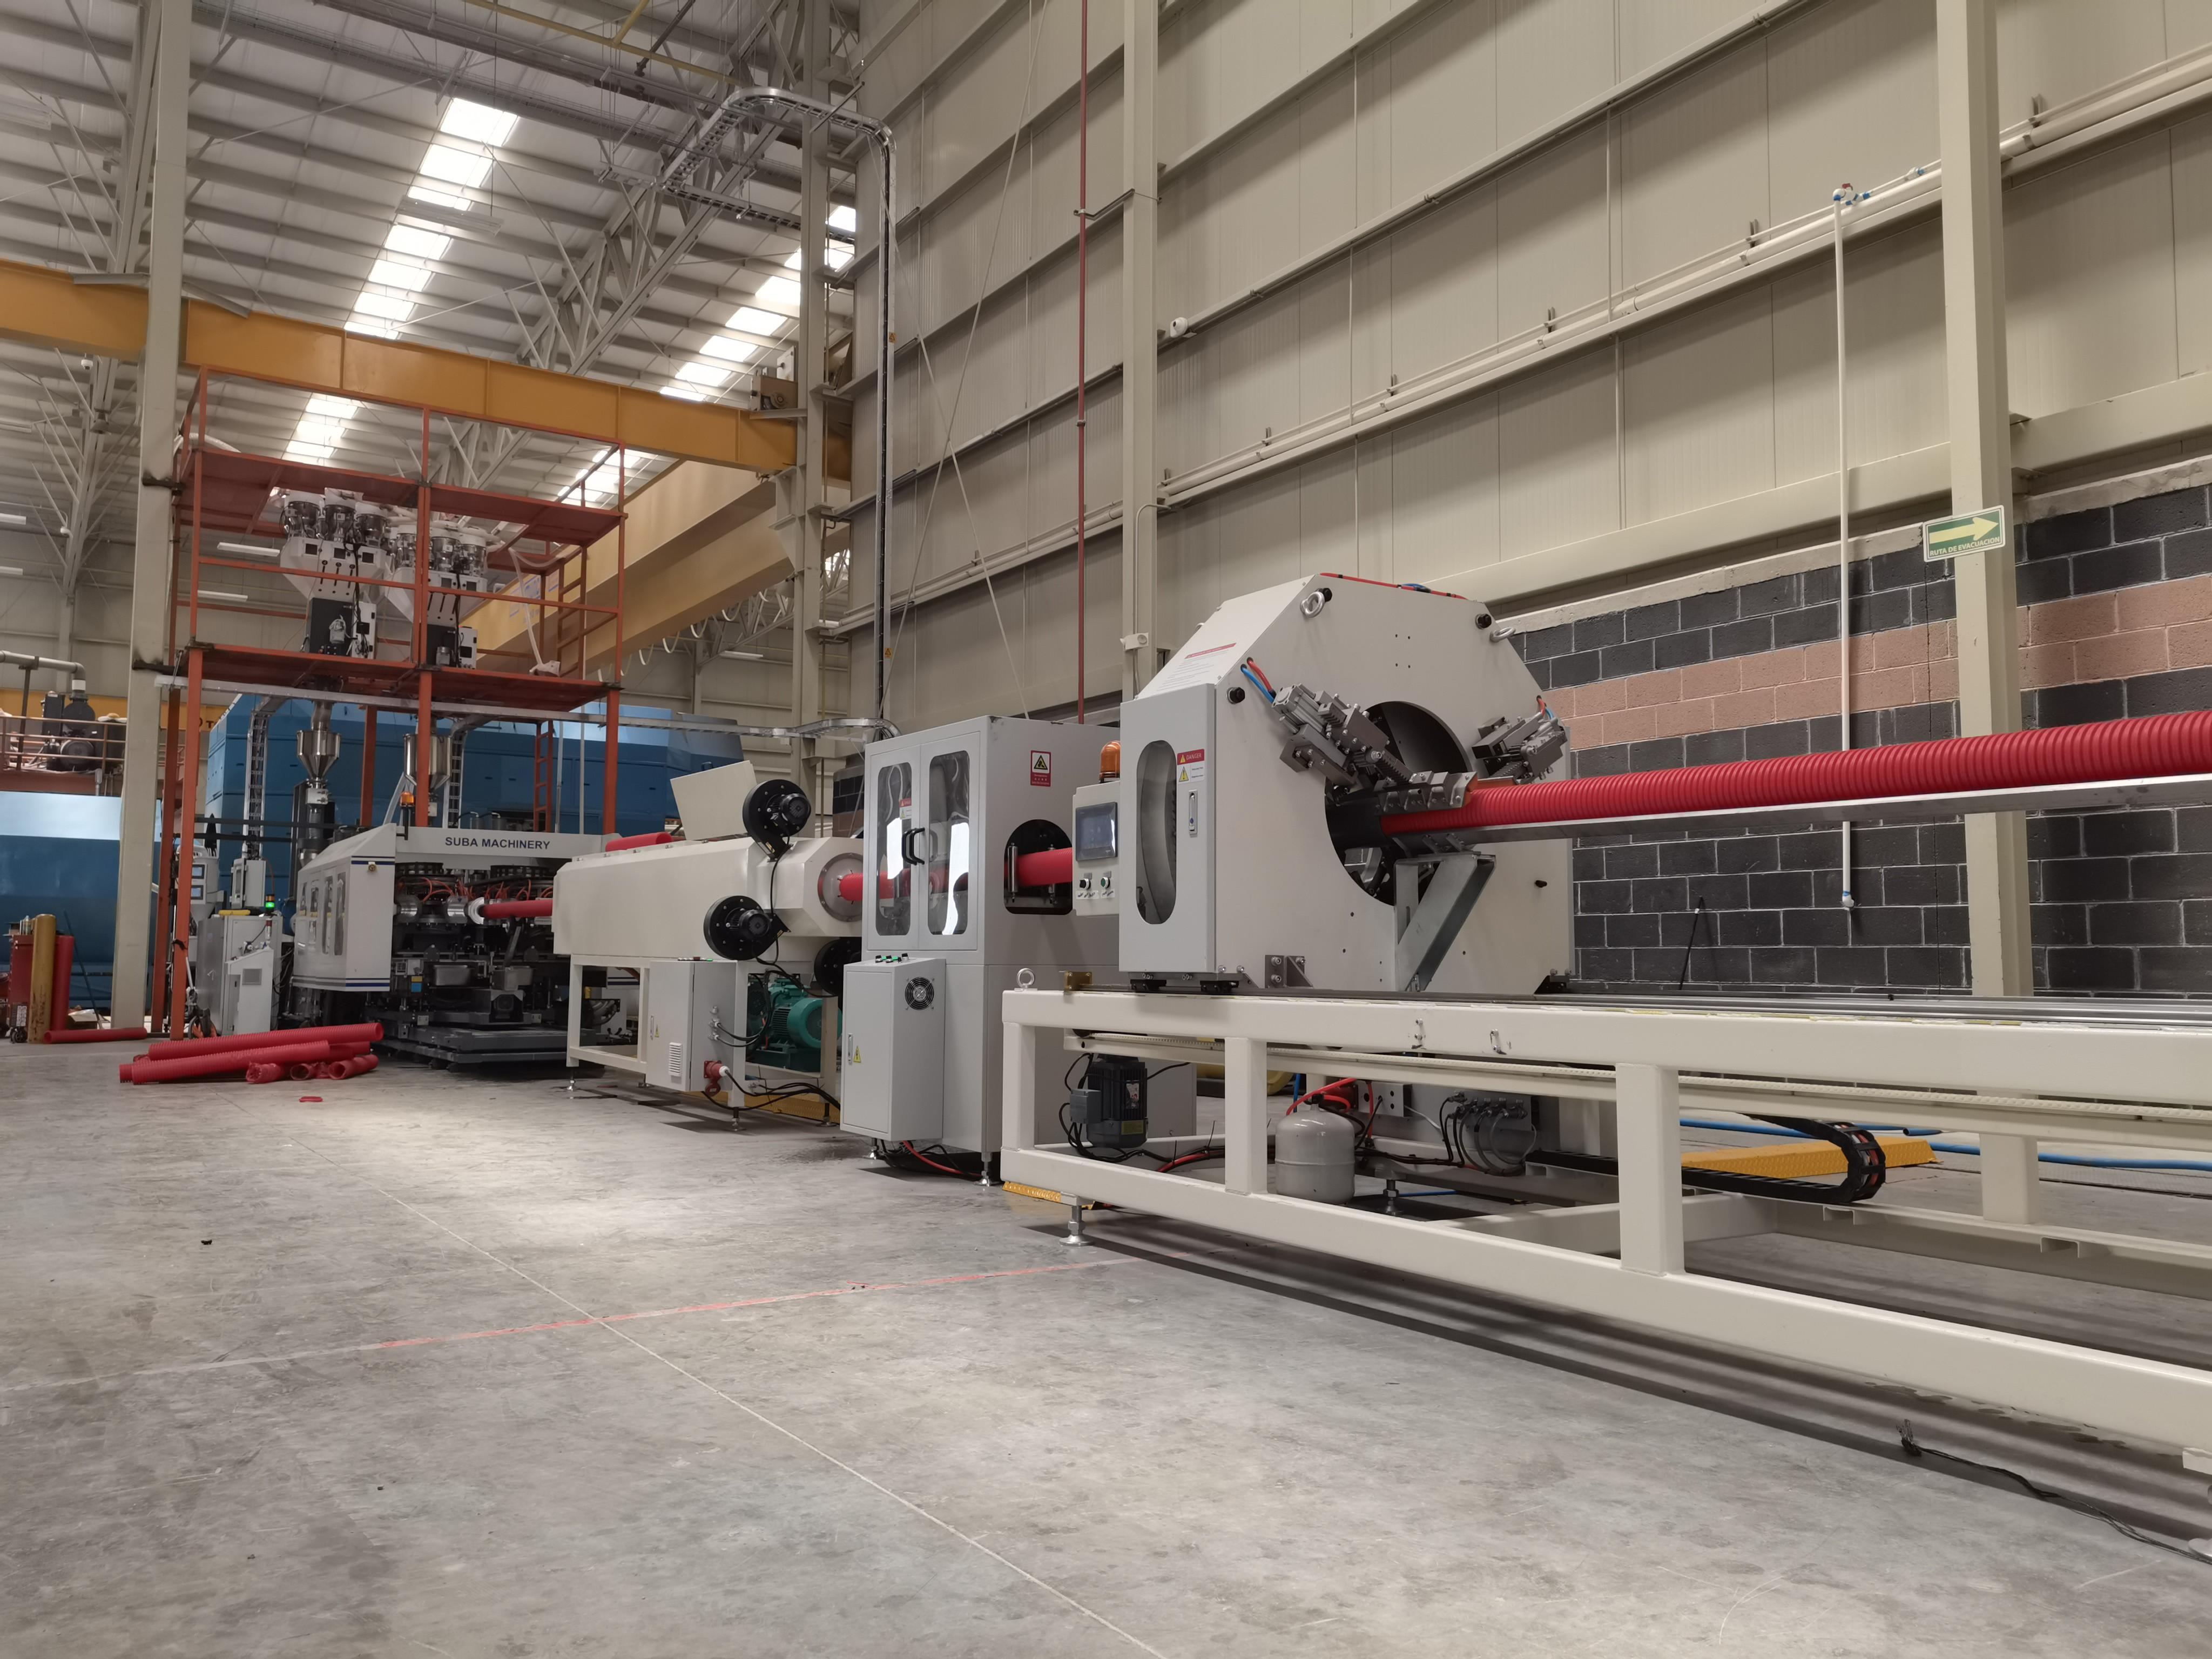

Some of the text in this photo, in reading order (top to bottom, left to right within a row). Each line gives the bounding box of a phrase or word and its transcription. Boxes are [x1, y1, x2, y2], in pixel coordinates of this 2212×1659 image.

[1930, 548, 1947, 556] RUTA
[1958, 536, 2000, 551] EVACUACION
[445, 837, 550, 849] SUBA MACHINERY
